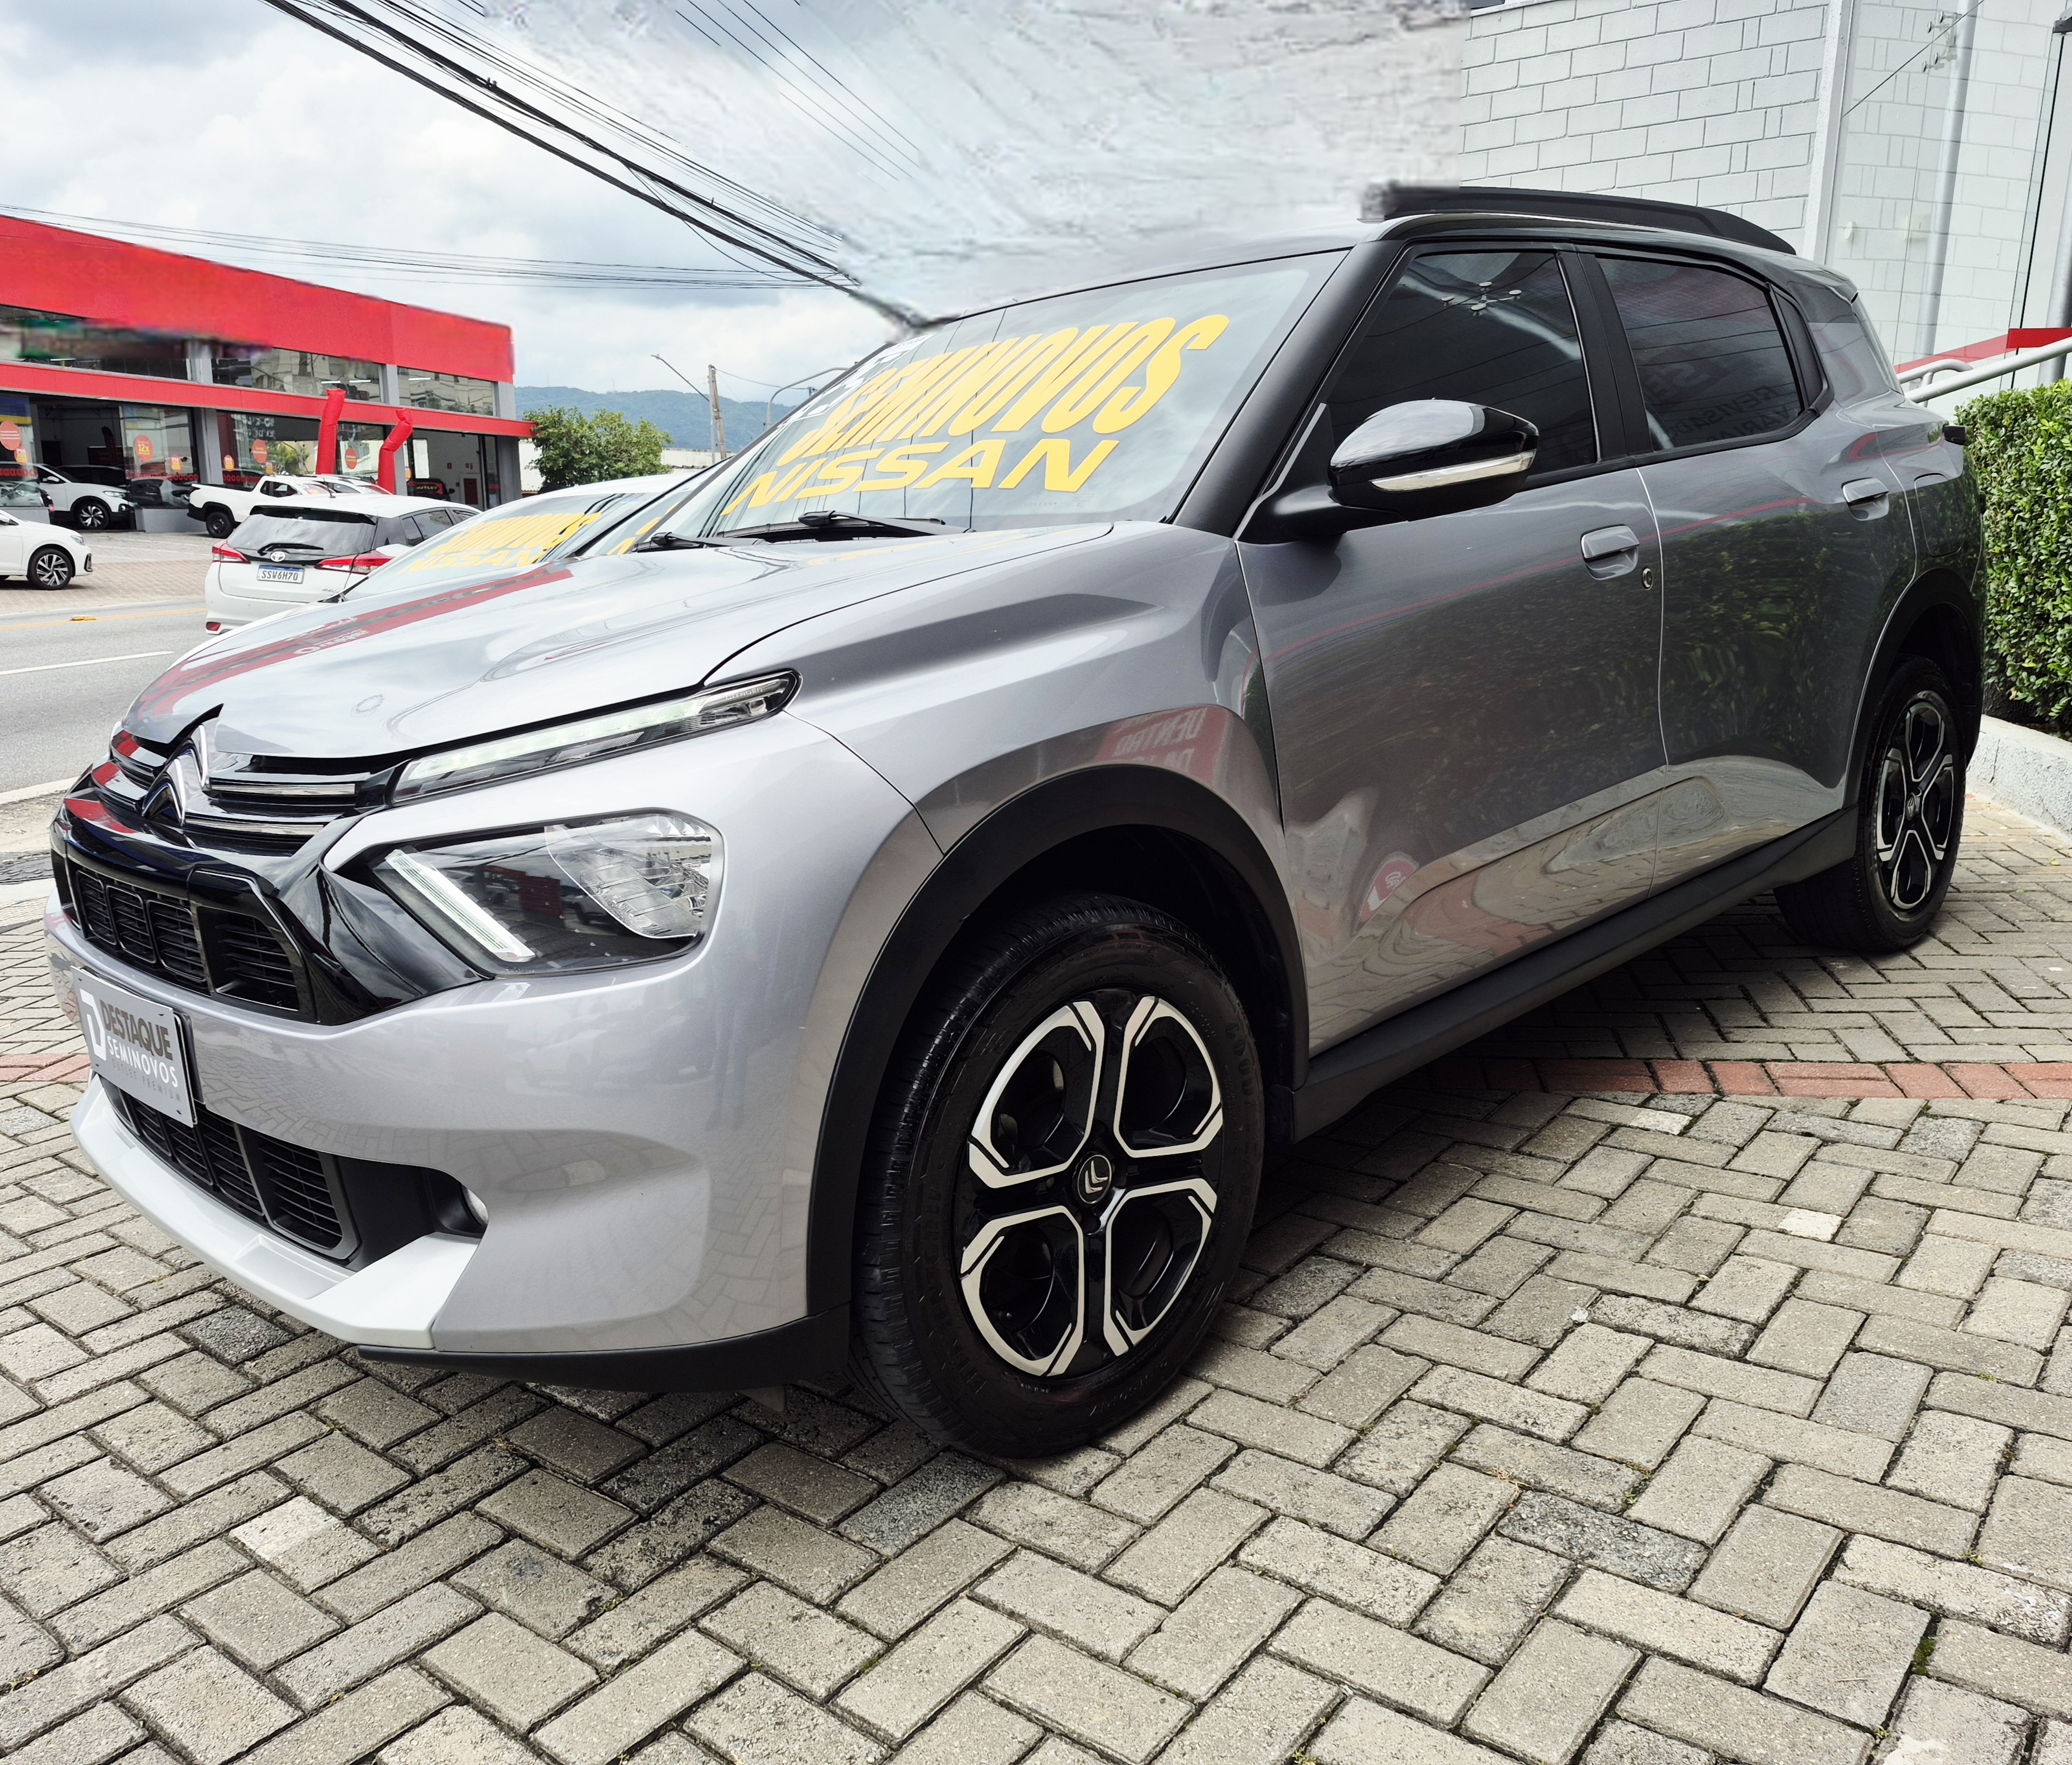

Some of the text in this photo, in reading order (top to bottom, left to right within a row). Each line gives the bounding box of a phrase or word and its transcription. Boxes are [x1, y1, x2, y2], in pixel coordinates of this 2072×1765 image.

[777, 315, 1229, 467] SEMINOVOS
[721, 438, 1118, 516] NISSAN
[261, 570, 298, 581] SSW6H70
[398, 550, 547, 575] NISSAN
[99, 999, 174, 1061] DESTAQUE
[106, 1035, 178, 1088] SEMINOVOS
